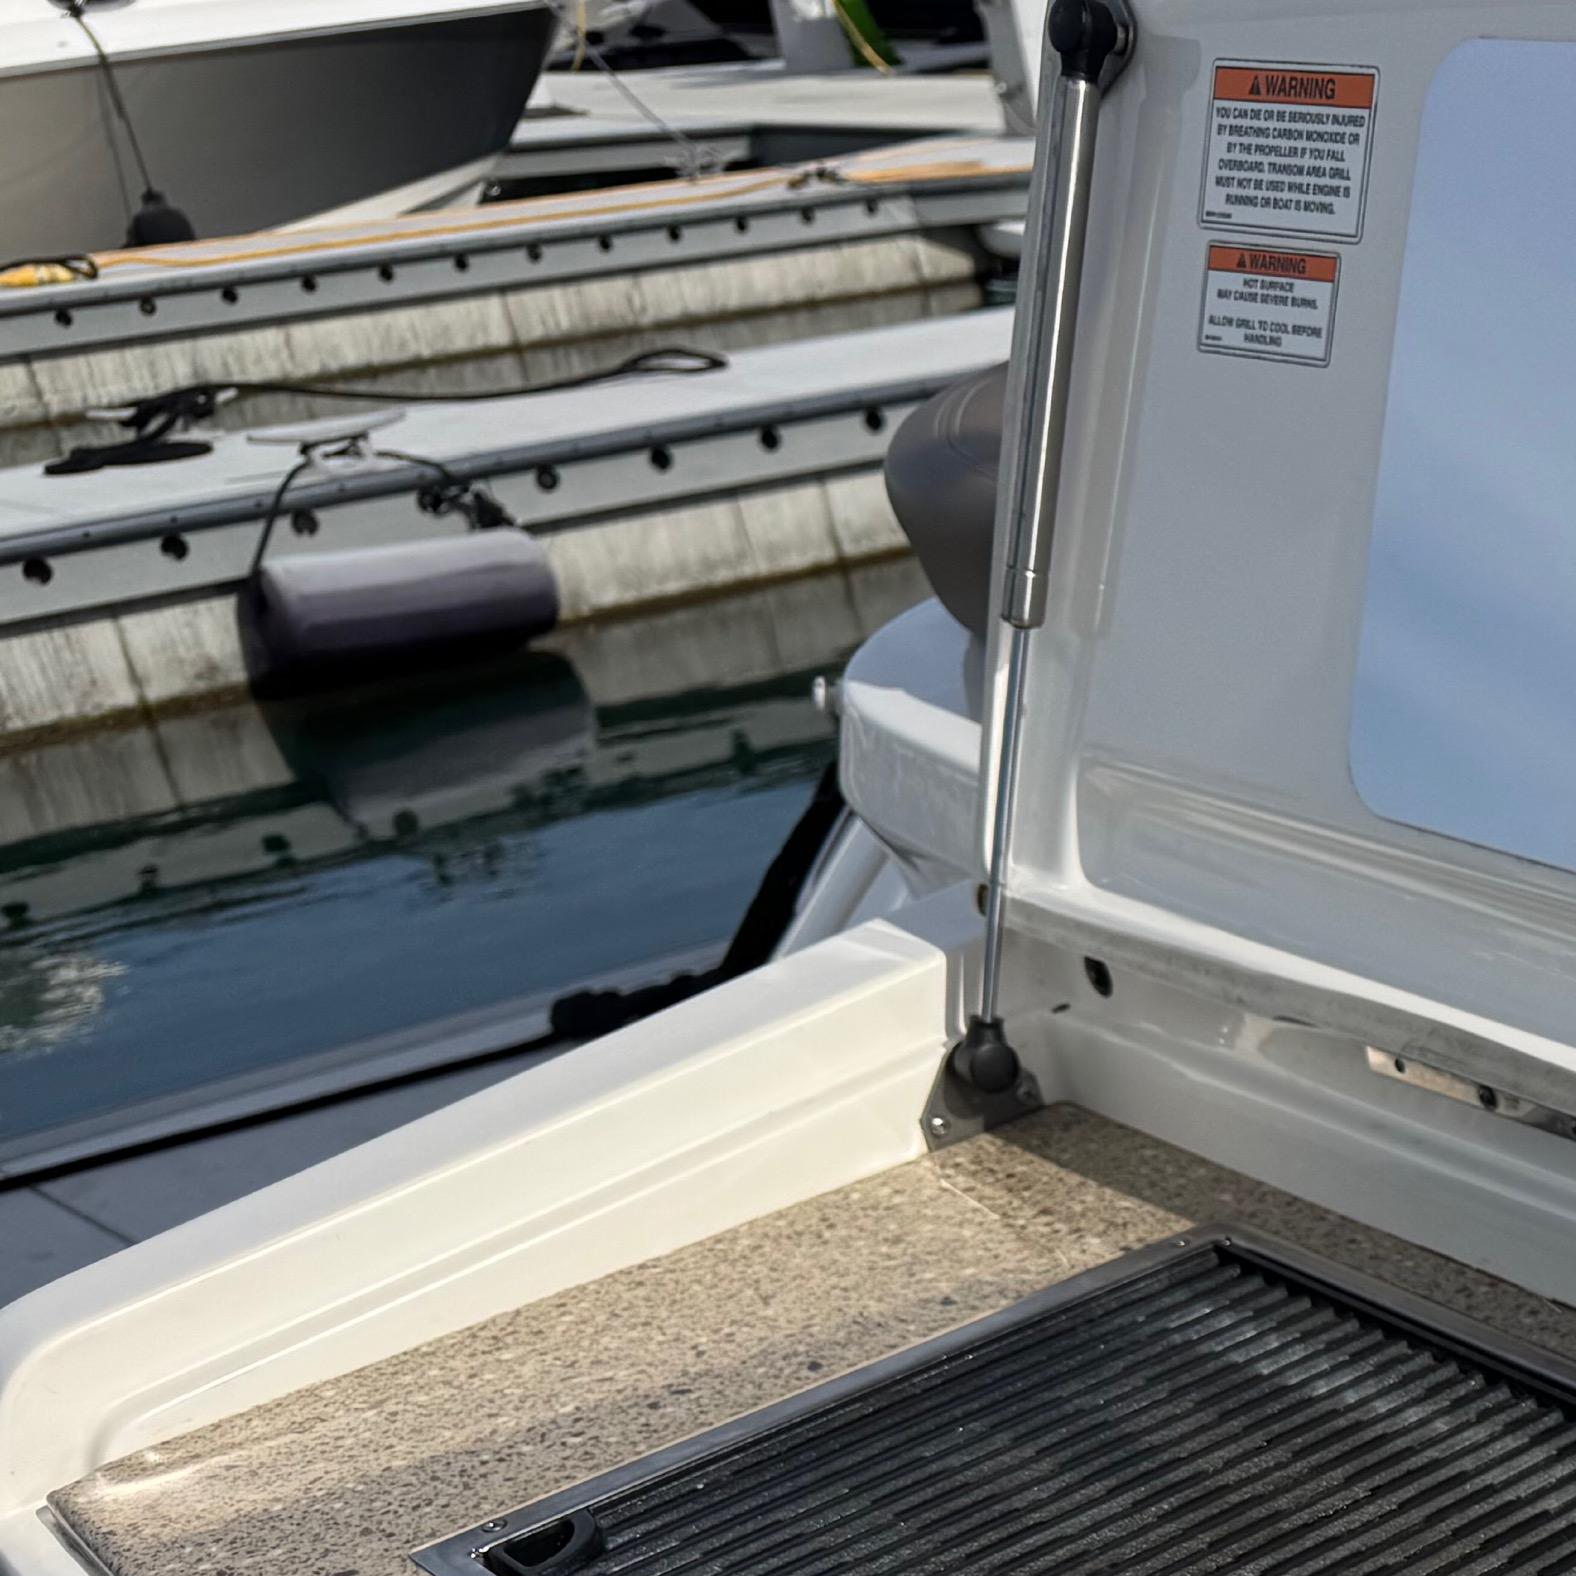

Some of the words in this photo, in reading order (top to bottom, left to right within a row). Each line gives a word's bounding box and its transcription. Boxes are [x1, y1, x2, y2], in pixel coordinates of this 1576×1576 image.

[1265, 74, 1336, 100] WARNING
[1215, 106, 1231, 118] YOU
[1232, 107, 1248, 119] CAN
[1249, 108, 1262, 120] DIE
[1262, 109, 1274, 121] OR
[1275, 110, 1286, 122] BE
[1287, 111, 1330, 125] SERIOUSLY
[1330, 113, 1365, 127] INJURED
[1217, 123, 1227, 135] BY
[1228, 124, 1270, 138] BREATHING
[1271, 127, 1304, 141] CARBON
[1304, 129, 1346, 144] MONOXIDE
[1347, 132, 1360, 144] OR
[1226, 141, 1236, 153] BY
[1237, 142, 1252, 154] THE
[1253, 143, 1298, 158] PROPELLER
[1299, 147, 1307, 158] IF
[1308, 147, 1325, 160] YOU
[1325, 148, 1345, 161] FALL
[1266, 161, 1305, 176] TRANSOM
[1306, 165, 1327, 178] AREA
[1327, 166, 1351, 180] GRILL
[1214, 175, 1235, 188] MUST
[1236, 177, 1252, 189] NOT
[1253, 178, 1263, 190] BE
[1265, 179, 1285, 192] USED
[1287, 181, 1310, 194] WHILE
[1311, 183, 1341, 197] ENGINE
[1342, 185, 1350, 198] IS
[1225, 193, 1258, 207] RUNNING
[1259, 196, 1271, 208] OR
[1272, 197, 1293, 210] BOAT
[1294, 199, 1302, 211] IS
[1249, 252, 1306, 275] WARNING
[1243, 277, 1258, 288] HOT
[1259, 279, 1293, 292] SURFACE
[1217, 288, 1231, 300] MAY
[1233, 290, 1258, 303] CAUSE
[1259, 293, 1289, 306] SEVERE
[1208, 314, 1233, 327] ALLOW
[1235, 317, 1256, 330] GRILL
[1256, 320, 1268, 331] TO
[1269, 321, 1290, 334] COOL
[1290, 324, 1322, 338] BEFORE
[1243, 331, 1282, 347] HANDLING
